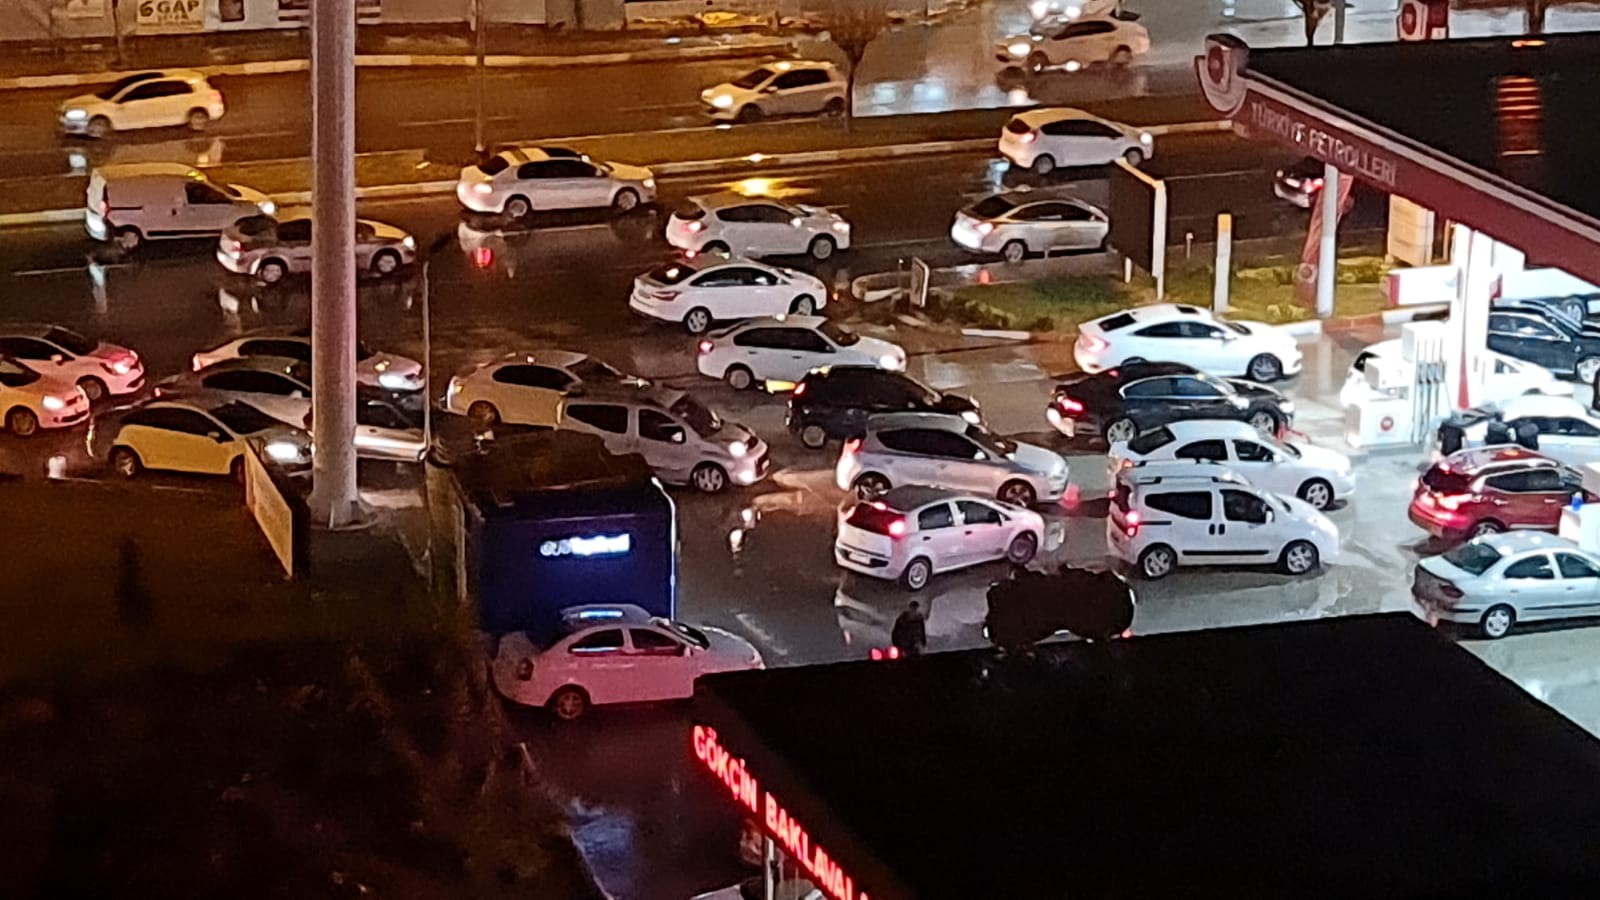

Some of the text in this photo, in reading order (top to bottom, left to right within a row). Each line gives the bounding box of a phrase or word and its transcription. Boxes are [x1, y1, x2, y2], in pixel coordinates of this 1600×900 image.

[1308, 127, 1397, 187] PETROLLERİ
[693, 724, 869, 900] GÖKÇİN BAKLAVAL
